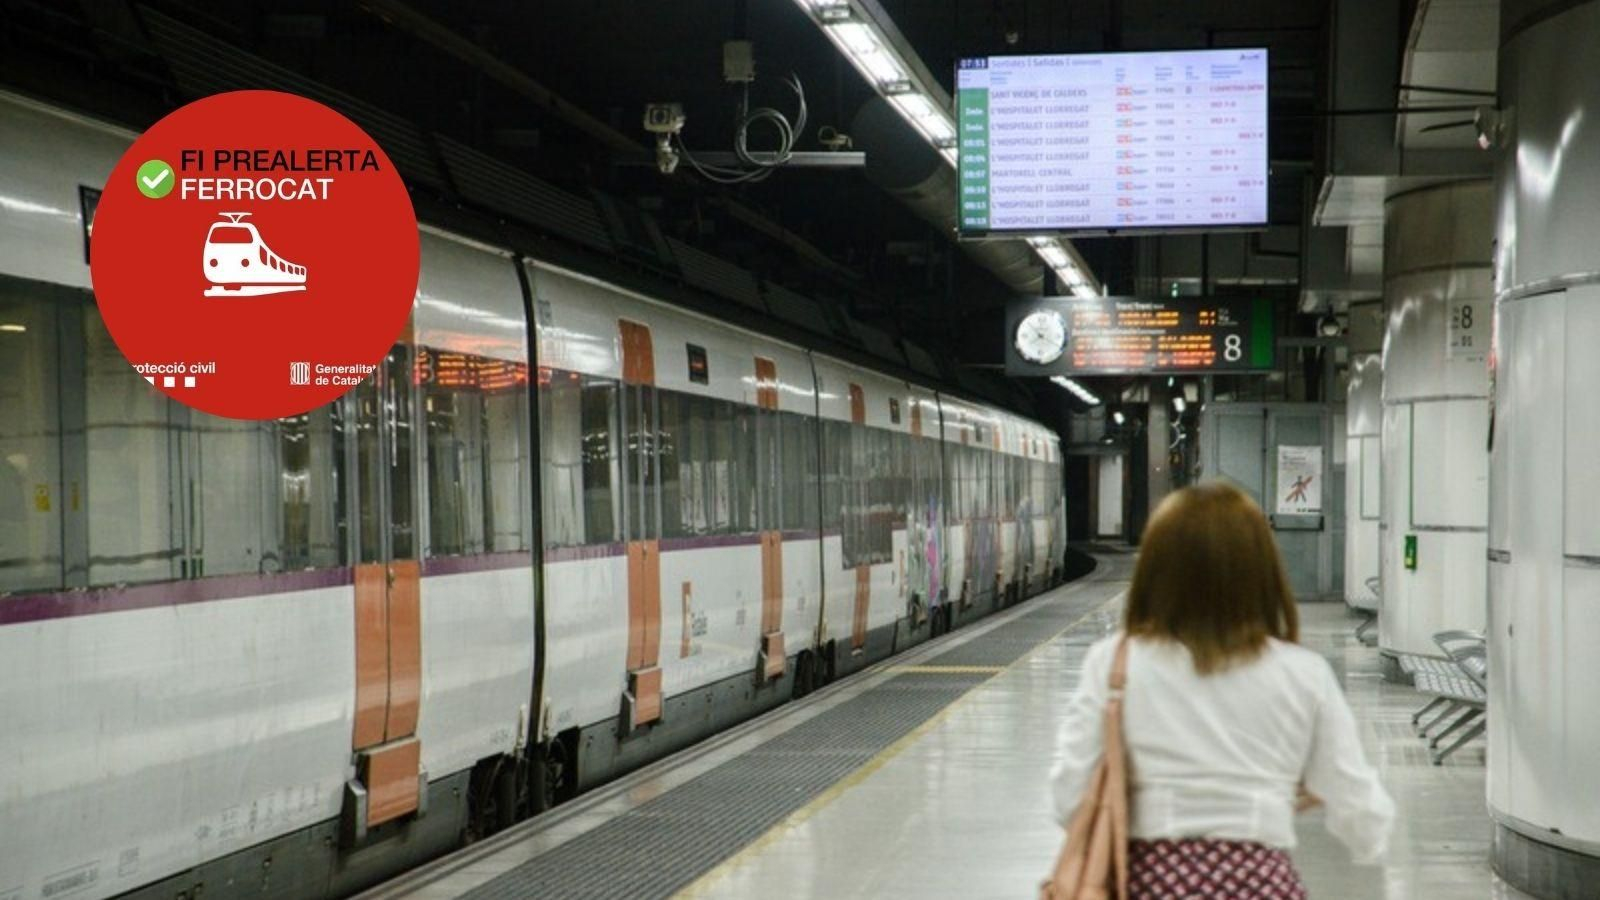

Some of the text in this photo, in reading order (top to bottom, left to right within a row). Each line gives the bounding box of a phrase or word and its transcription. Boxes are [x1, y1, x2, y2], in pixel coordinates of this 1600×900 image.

[1032, 58, 1064, 67] Salidas
[1461, 305, 1473, 329] 8
[1223, 334, 1242, 361] 8
